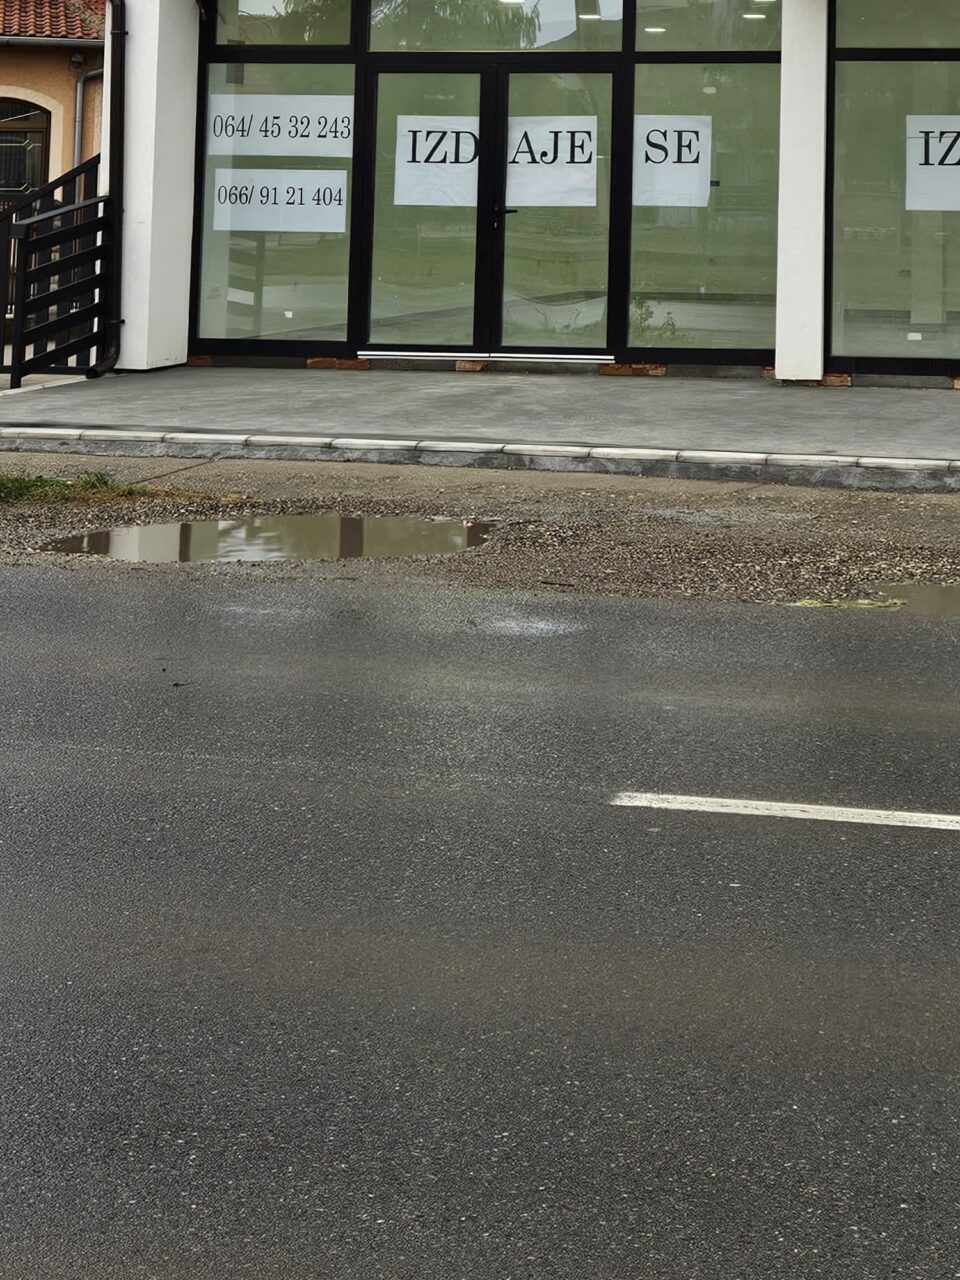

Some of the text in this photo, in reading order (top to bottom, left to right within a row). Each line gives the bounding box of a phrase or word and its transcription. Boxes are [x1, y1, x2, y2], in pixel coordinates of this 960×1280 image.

[213, 114, 351, 139] 064/ 45 32 243
[644, 129, 700, 165] SE
[218, 185, 343, 206] 066/ 91 21 404
